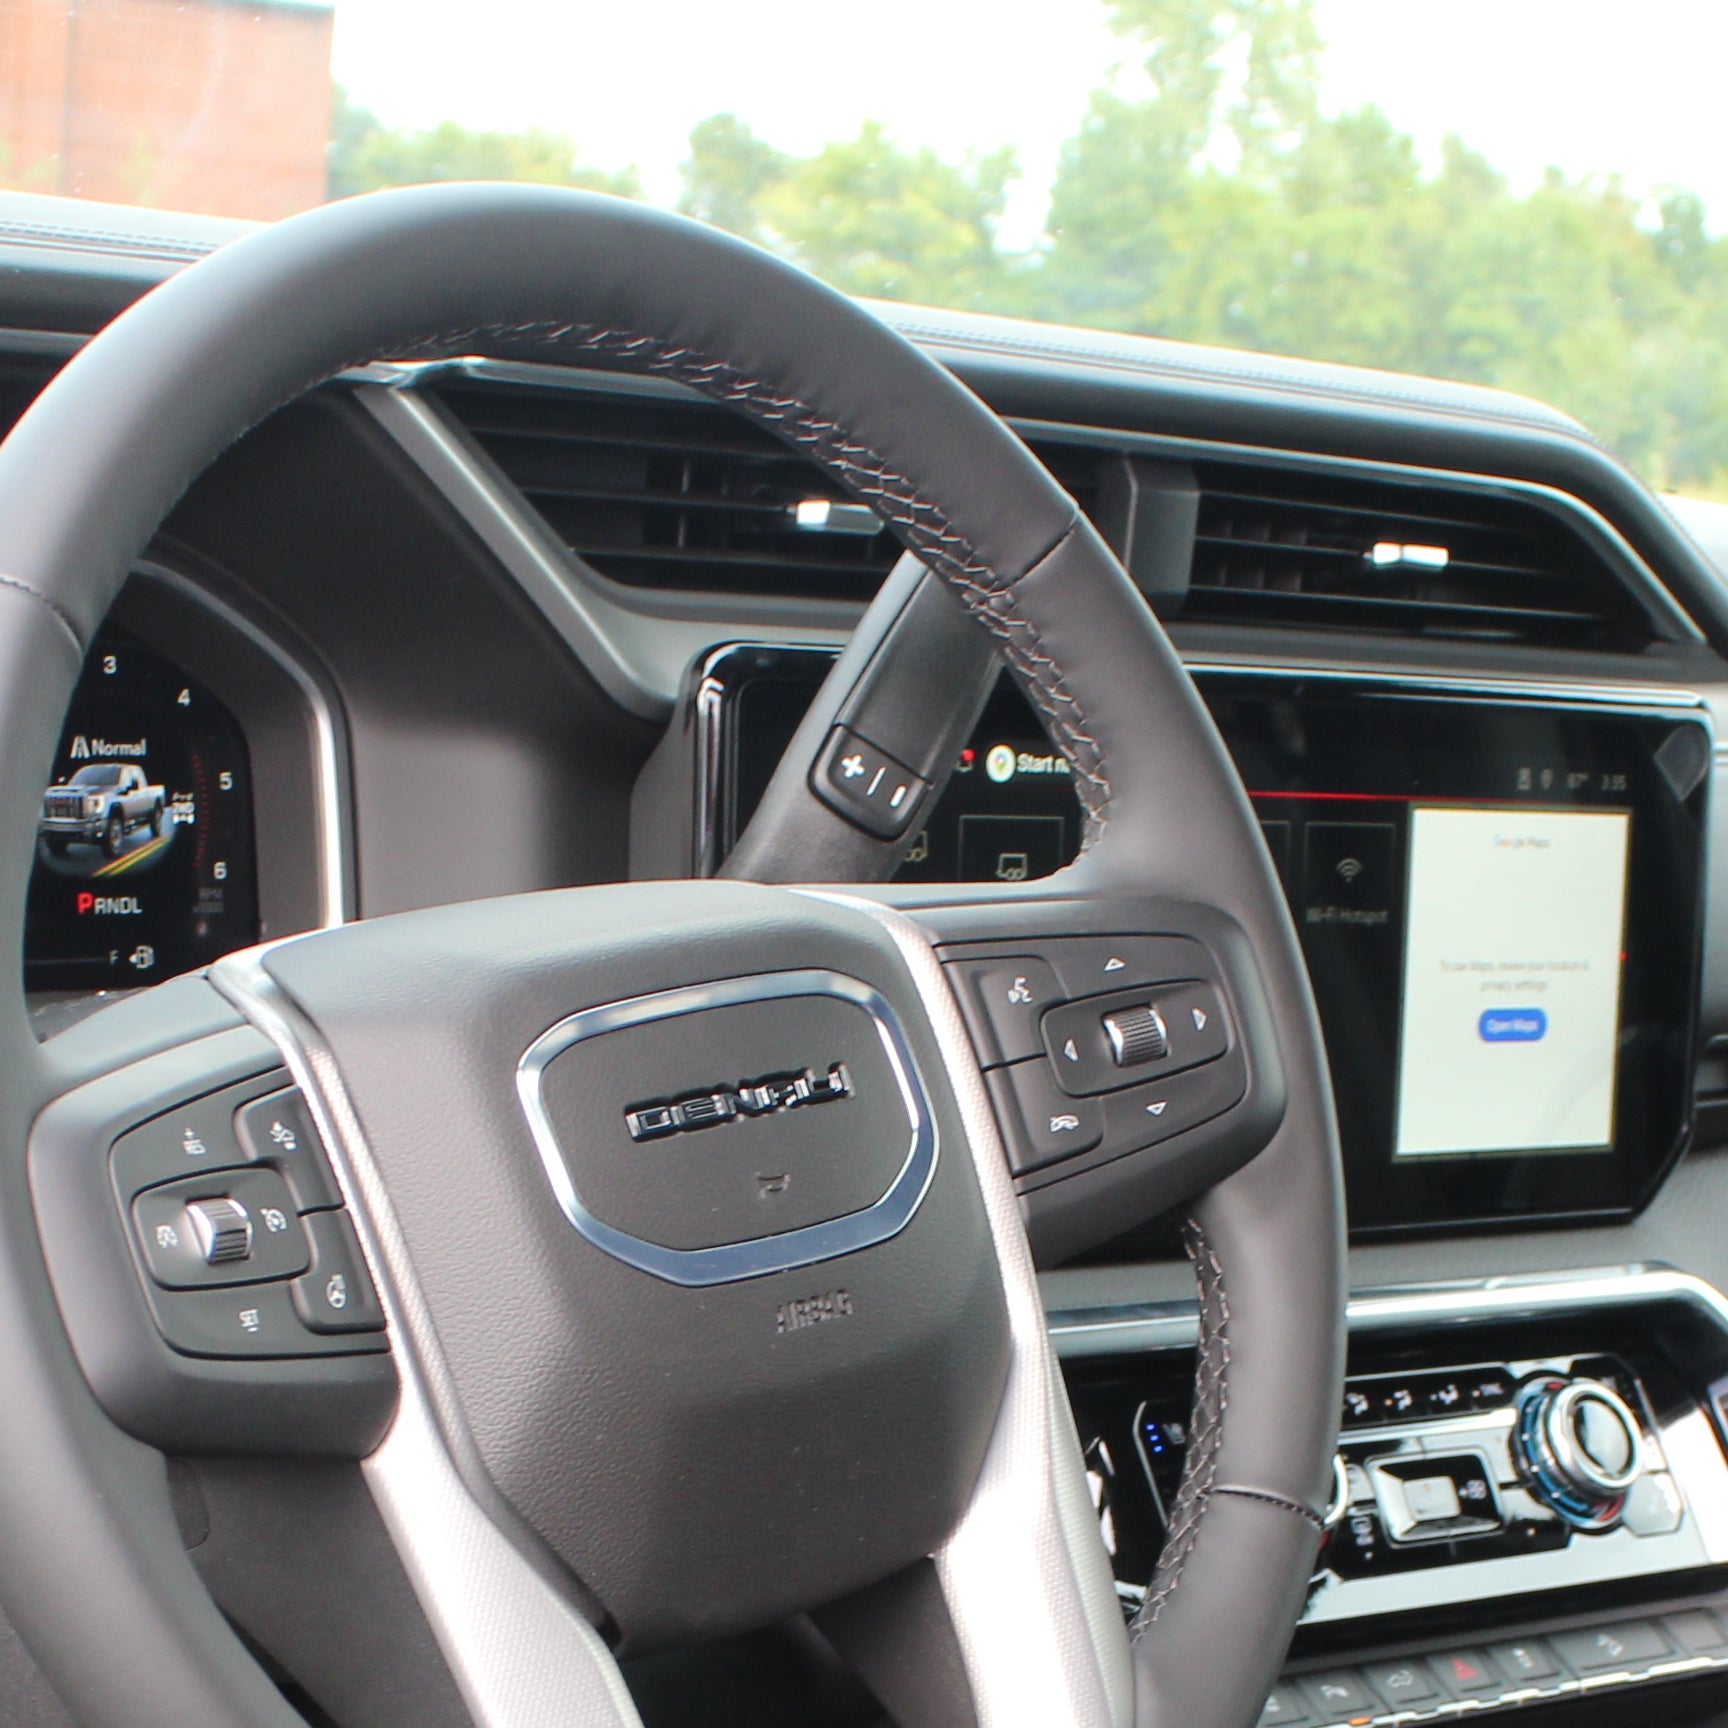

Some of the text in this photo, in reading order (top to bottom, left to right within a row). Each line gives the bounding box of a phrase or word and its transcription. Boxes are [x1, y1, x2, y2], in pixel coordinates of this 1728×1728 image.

[103, 655, 117, 674] 3
[177, 688, 191, 706] 4
[91, 738, 147, 756] Normal
[1016, 753, 1054, 774] Start
[219, 771, 233, 790] 5
[214, 861, 227, 880] 6
[625, 1062, 856, 1142] DENALI
